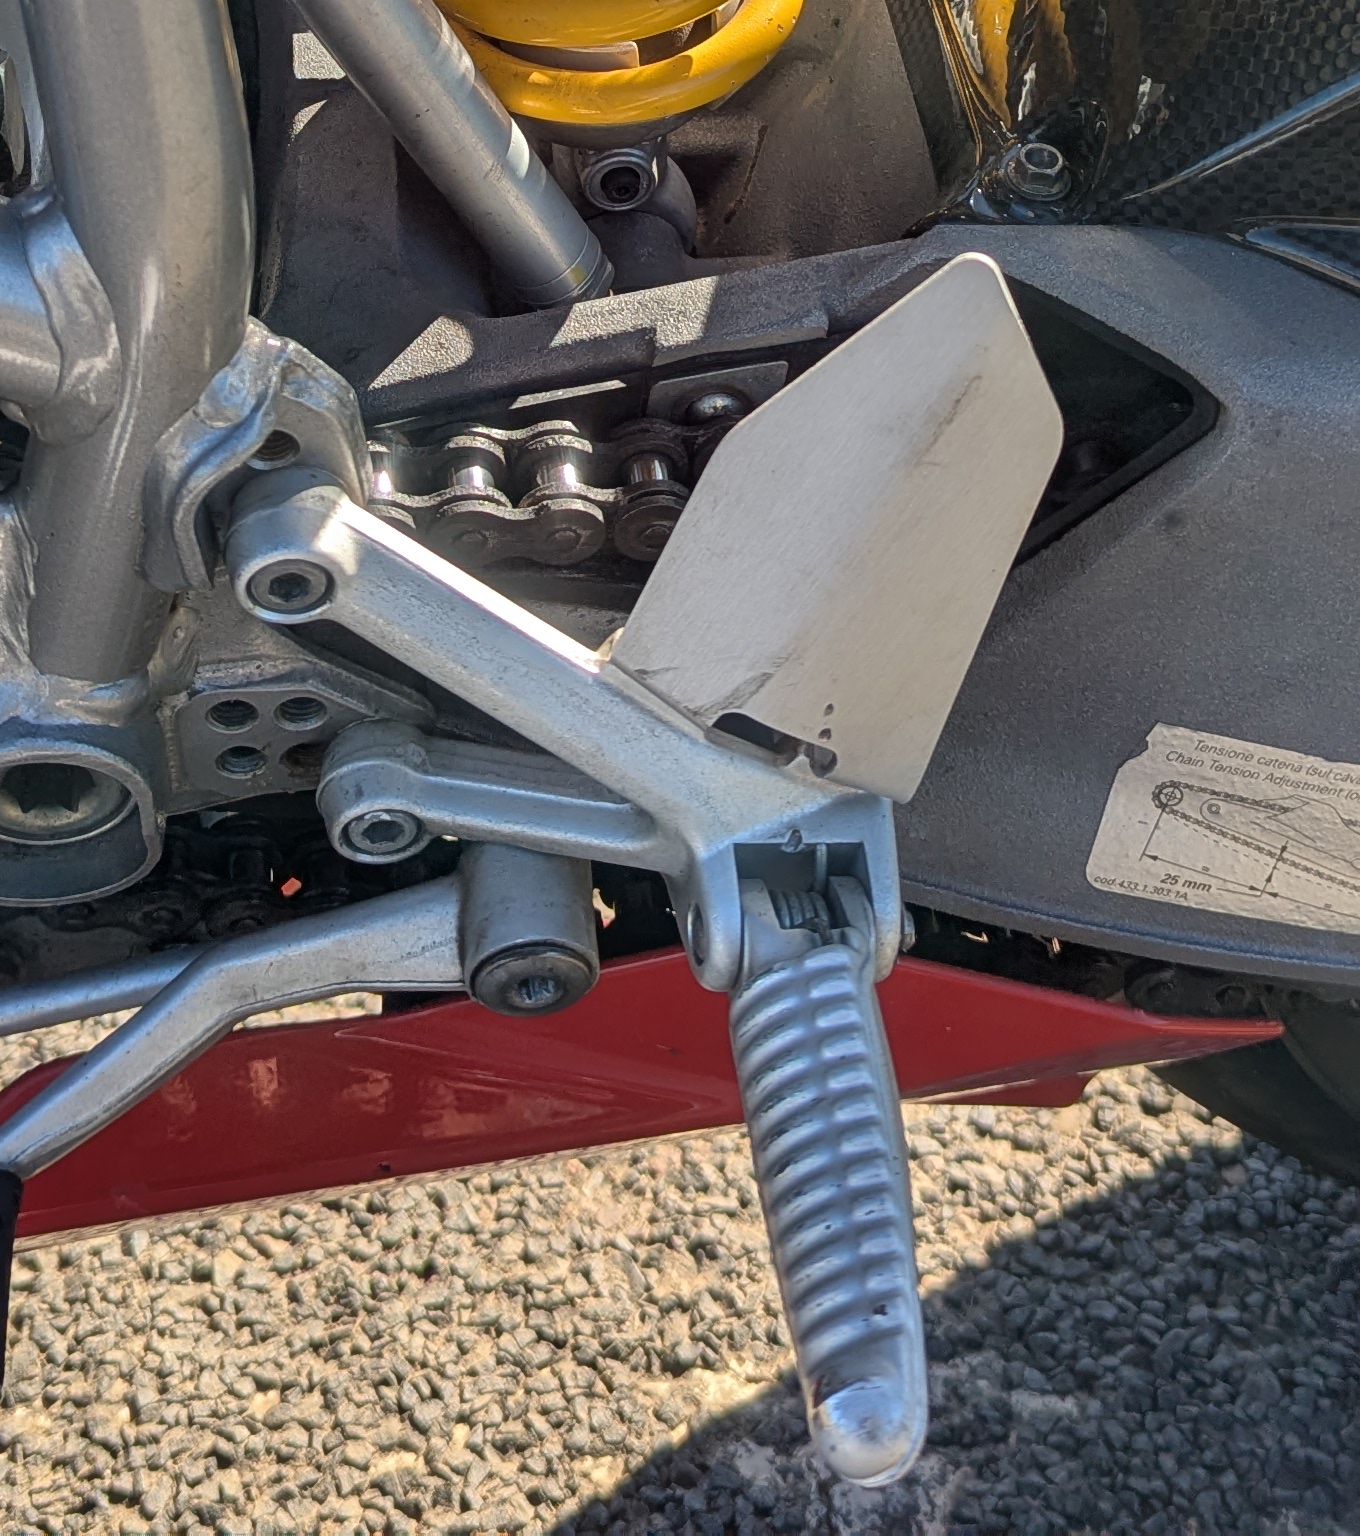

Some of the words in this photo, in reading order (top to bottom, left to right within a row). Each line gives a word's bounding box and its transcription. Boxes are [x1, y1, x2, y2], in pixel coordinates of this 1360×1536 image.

[1165, 750, 1205, 768] Chain
[1208, 758, 1261, 781] Tension
[1261, 771, 1345, 798] Adjustment
[1194, 739, 1255, 763] Tensione
[1256, 755, 1303, 774] catena
[1305, 764, 1333, 779] (sul
[1160, 872, 1181, 886] 25
[1181, 879, 1212, 893] mm
